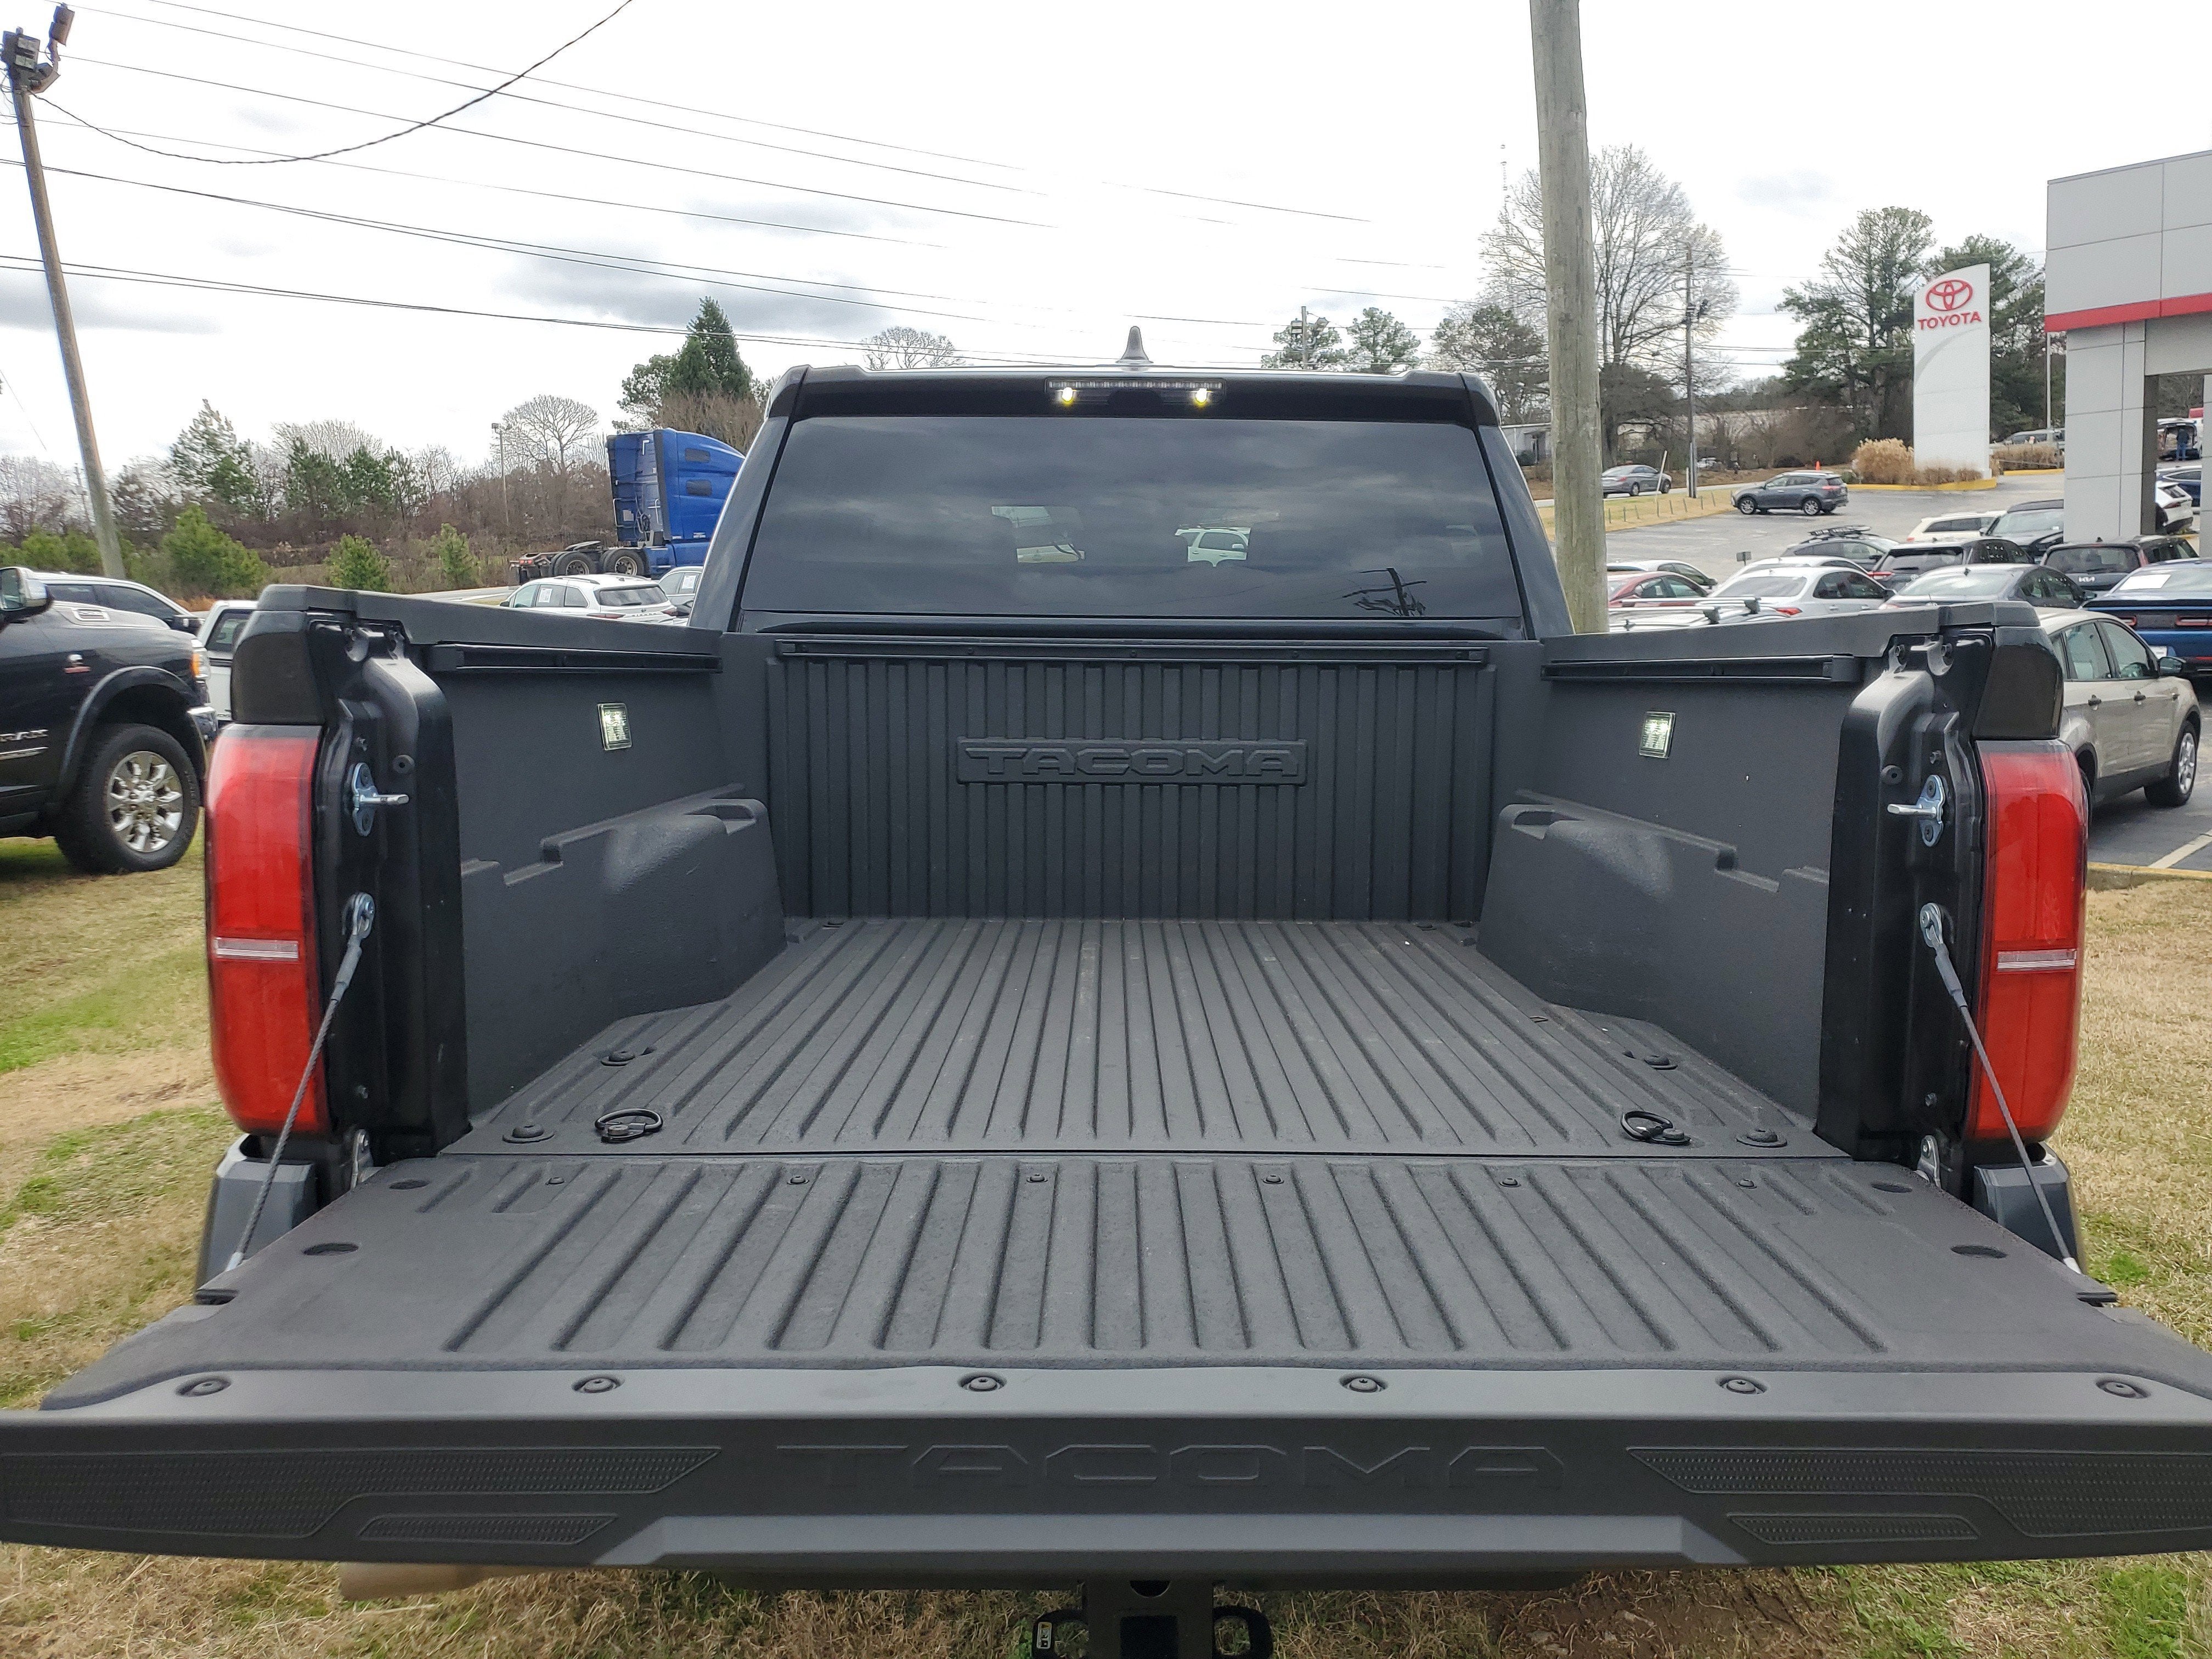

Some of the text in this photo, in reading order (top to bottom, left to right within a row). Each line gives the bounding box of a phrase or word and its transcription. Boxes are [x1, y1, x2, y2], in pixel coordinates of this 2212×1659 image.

[1917, 311, 1982, 330] TOYOTA
[966, 747, 1299, 777] TACOMA
[776, 1444, 1565, 1489] TACOMA
